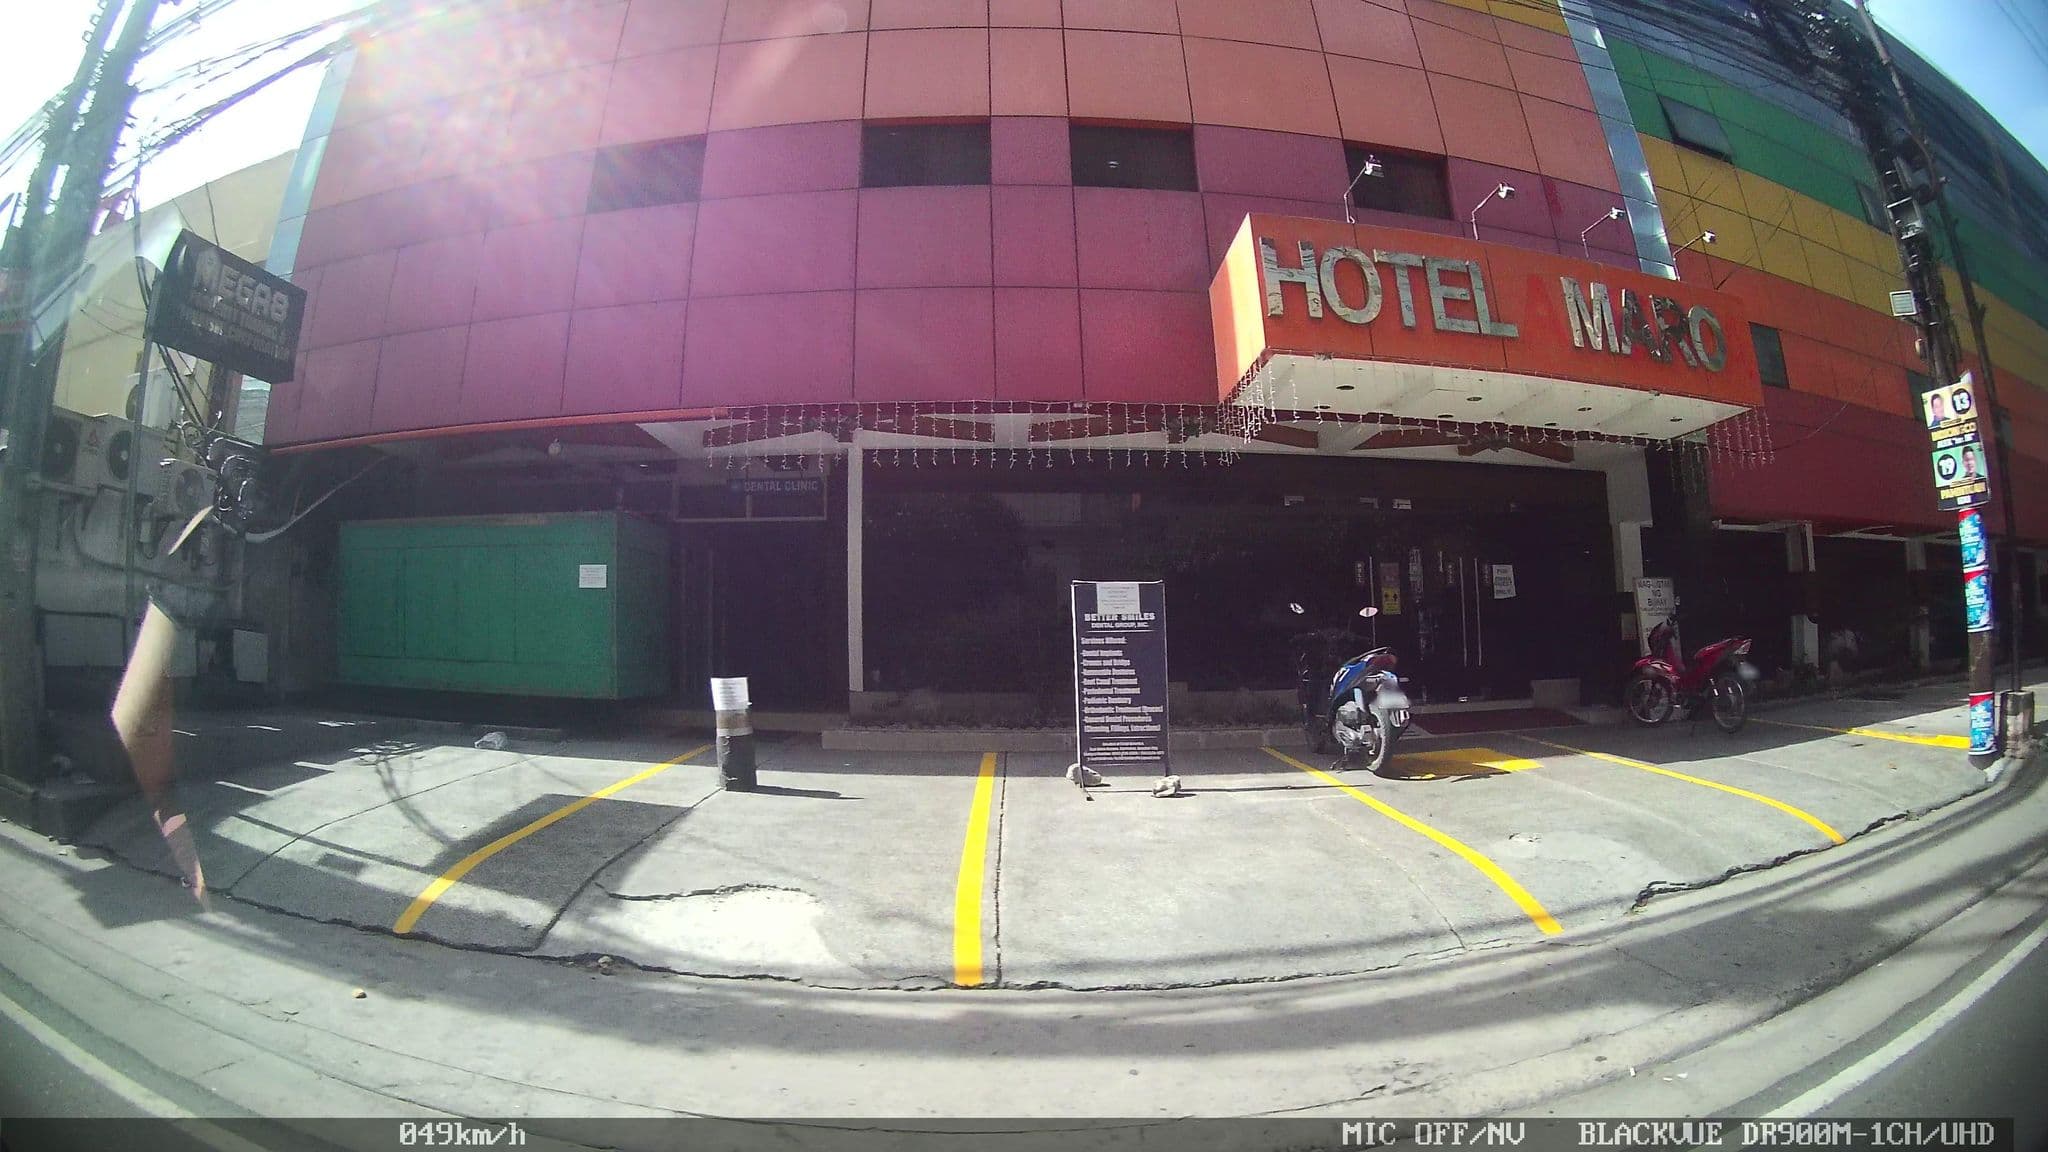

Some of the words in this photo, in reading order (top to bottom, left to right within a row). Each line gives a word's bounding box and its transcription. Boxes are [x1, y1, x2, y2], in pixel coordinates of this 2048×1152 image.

[1258, 236, 1519, 338] HOTEL
[1953, 391, 1970, 411] 13
[1938, 458, 1955, 476] 19
[743, 481, 781, 491] DENTAL
[784, 480, 818, 490] CLINIC
[1084, 613, 1118, 621] BETTER
[1121, 612, 1156, 621] SMILES
